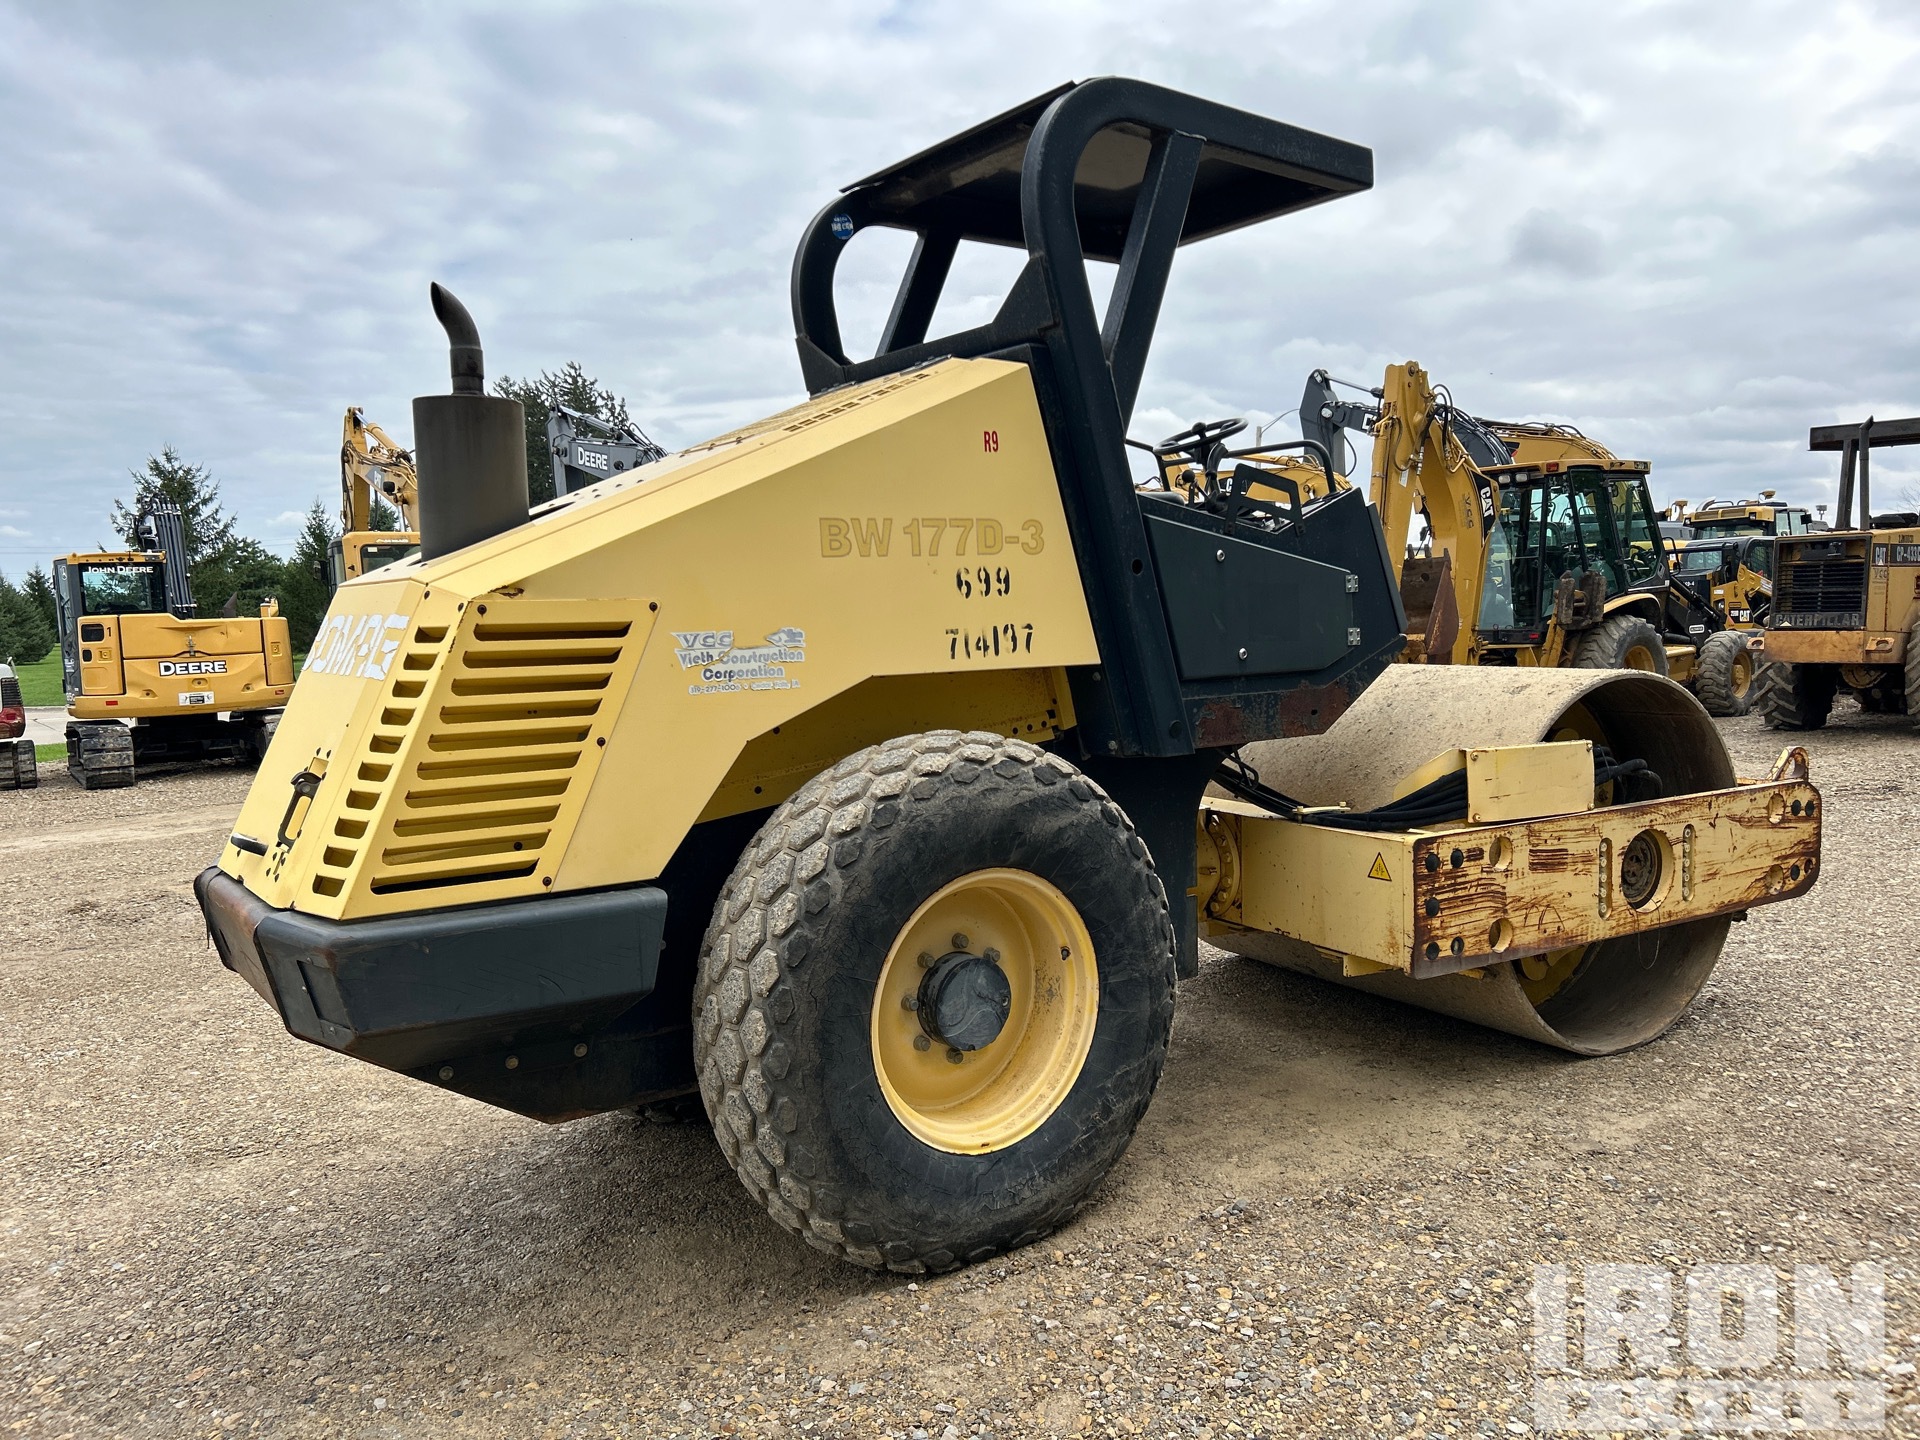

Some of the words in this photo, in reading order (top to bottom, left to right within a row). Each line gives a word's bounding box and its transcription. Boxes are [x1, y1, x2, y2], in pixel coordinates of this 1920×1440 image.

[983, 430, 999, 453] R9
[577, 446, 608, 471] DEERE
[1480, 486, 1494, 517] CAT
[819, 517, 893, 558] BW
[902, 518, 1044, 557] 177D-3
[1875, 547, 1886, 565] CAT
[117, 566, 154, 574] DEERE
[956, 566, 1010, 599] 699
[1740, 610, 1750, 622] CAT
[1775, 613, 1860, 627] CATERPILLAR
[676, 632, 733, 648] VCC
[680, 651, 714, 667] Vieth
[718, 649, 804, 665] Construction
[159, 661, 227, 676] DEERE
[703, 665, 784, 682] Corporation
